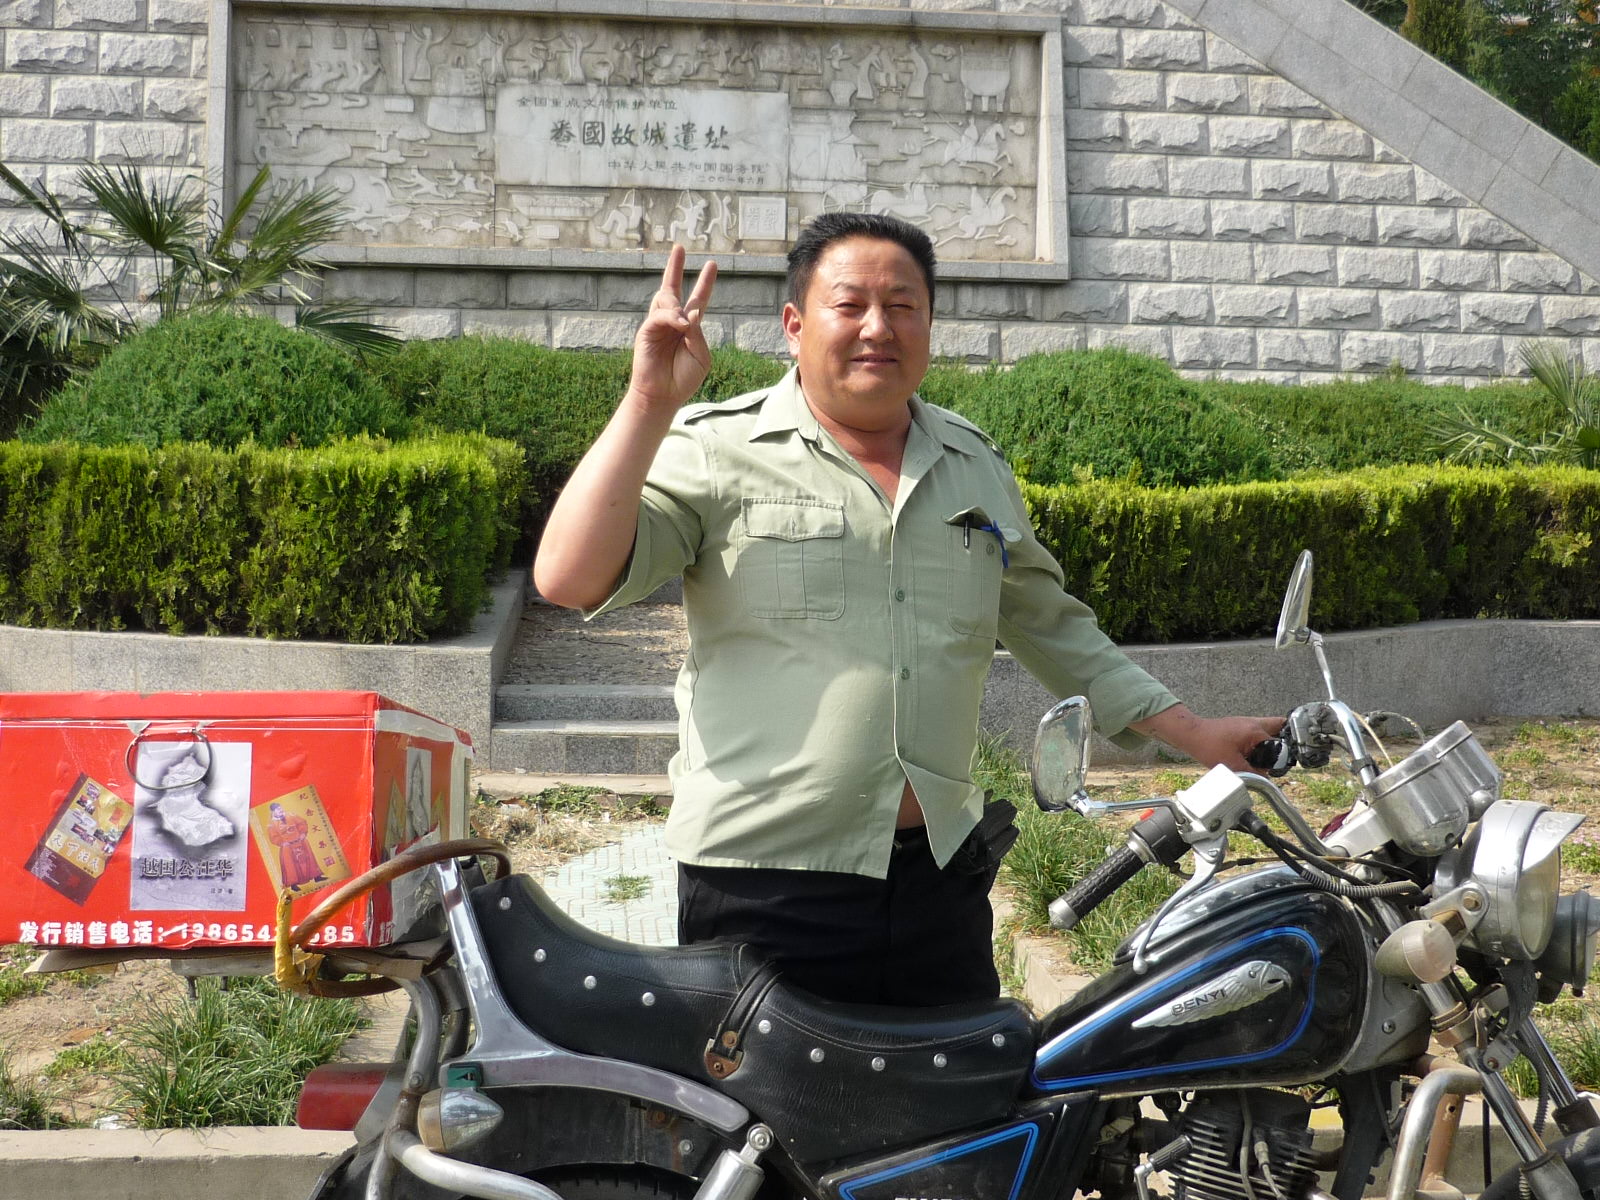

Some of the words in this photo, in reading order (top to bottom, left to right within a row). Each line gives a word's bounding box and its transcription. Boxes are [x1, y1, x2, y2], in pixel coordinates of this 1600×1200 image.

[141, 857, 234, 879] 越国公汪华
[1171, 988, 1227, 1016] BENYI
